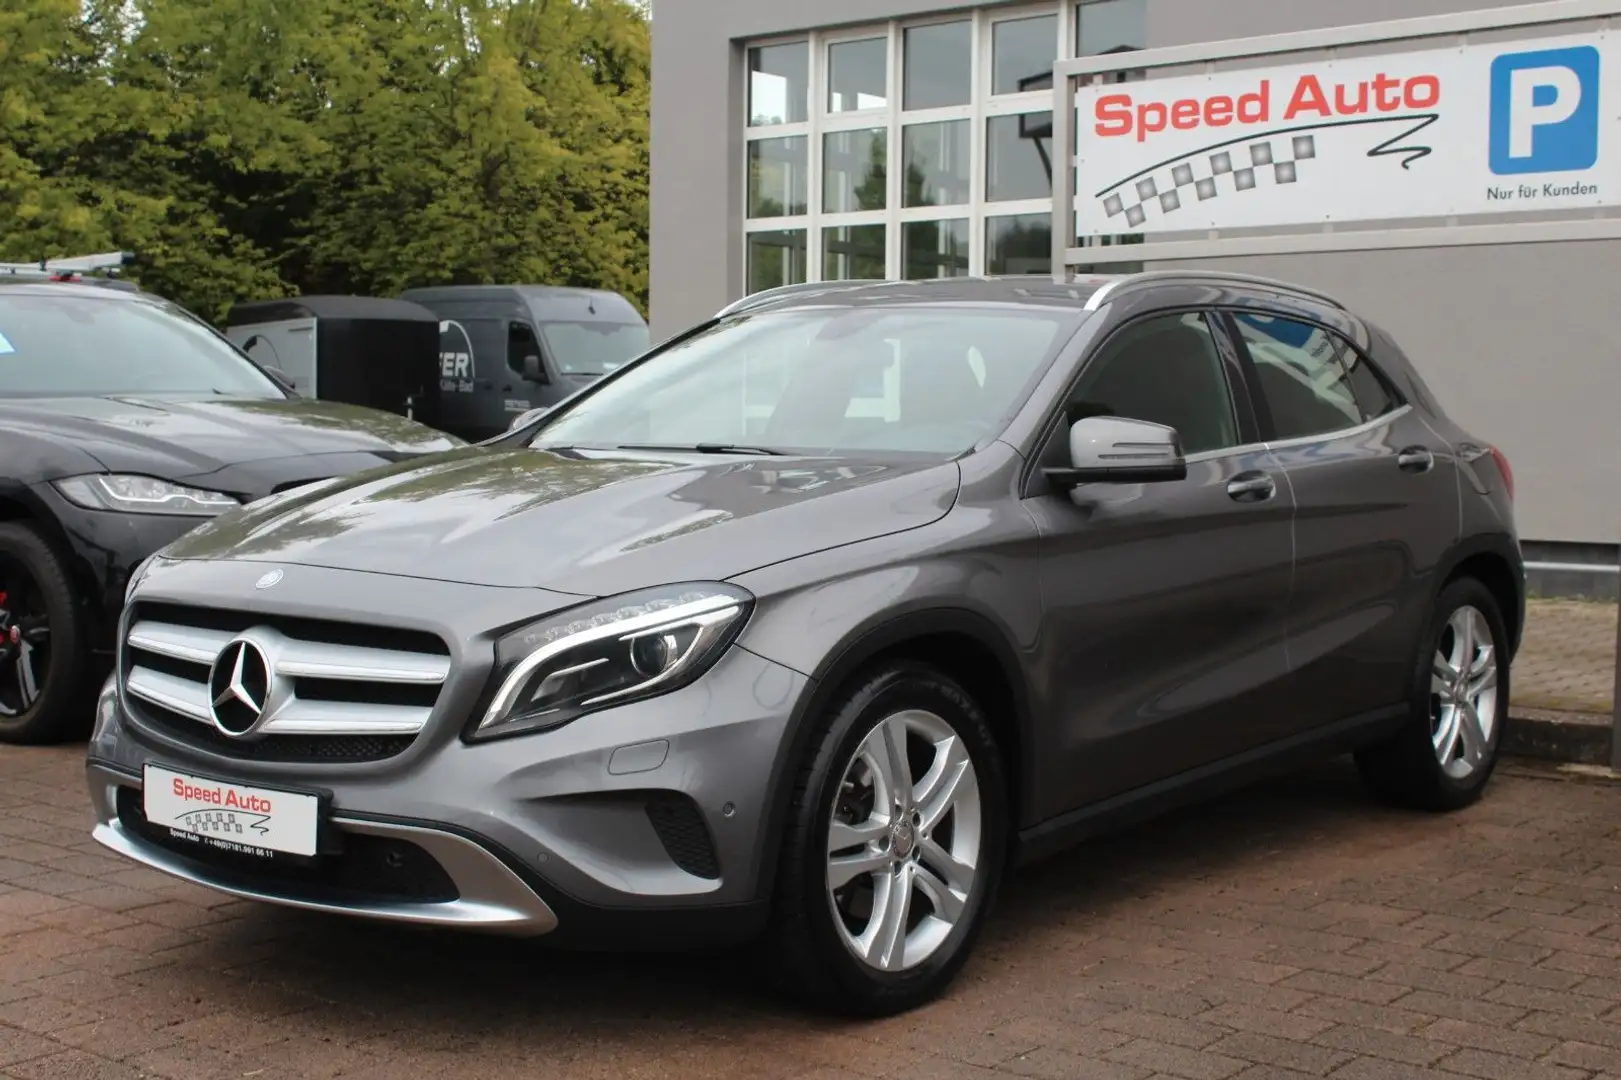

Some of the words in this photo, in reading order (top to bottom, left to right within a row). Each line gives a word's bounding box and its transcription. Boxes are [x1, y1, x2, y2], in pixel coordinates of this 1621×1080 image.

[1094, 79, 1270, 142] Speed
[1283, 74, 1440, 120] Auto
[1508, 65, 1582, 159] P
[1487, 187, 1513, 201] Nur
[1518, 184, 1538, 198] für
[1543, 181, 1597, 197] Kunden
[173, 778, 221, 804] Speed
[225, 789, 271, 813] Auto
[169, 827, 186, 839] Speed
[187, 832, 200, 842] Auto
